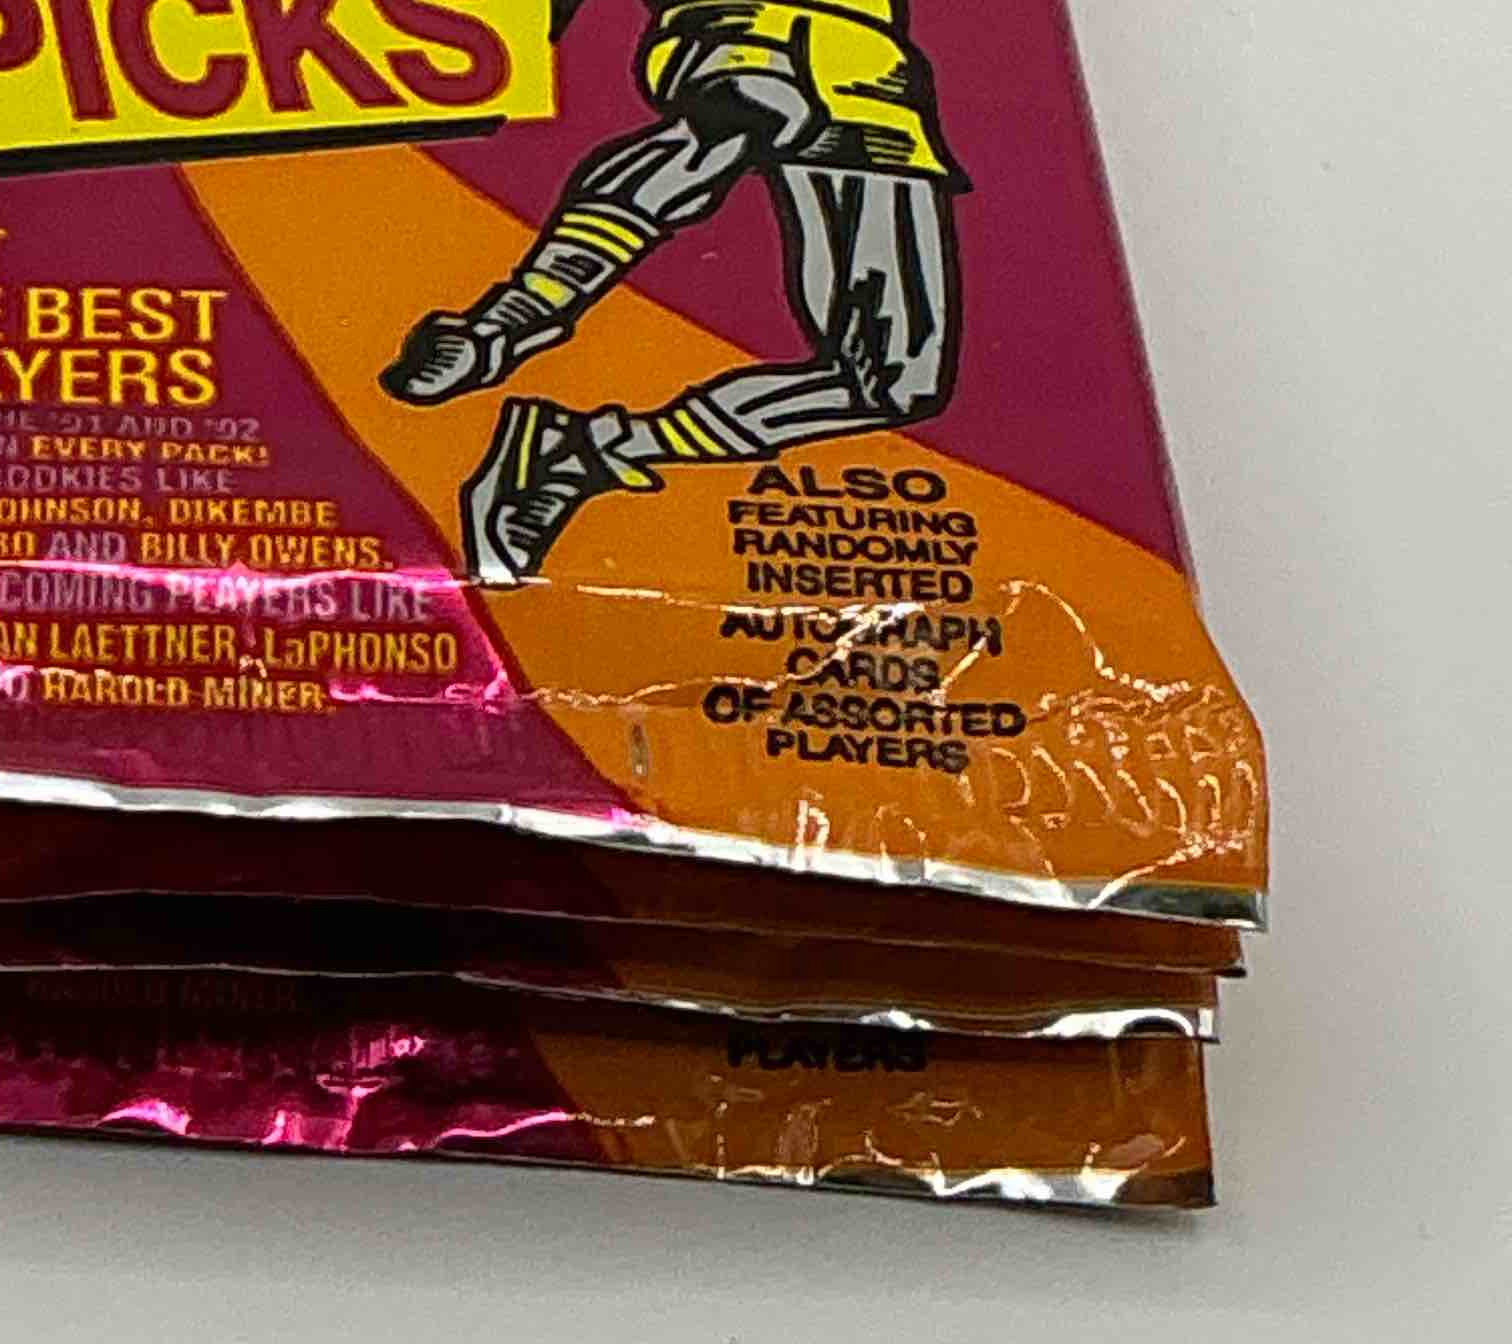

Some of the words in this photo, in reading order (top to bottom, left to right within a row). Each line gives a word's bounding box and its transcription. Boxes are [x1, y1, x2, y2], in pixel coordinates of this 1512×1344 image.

[26, 286, 227, 342] BEST
[115, 414, 192, 437] AND
[30, 435, 147, 460] EVERY
[159, 441, 269, 466] PACK!
[153, 468, 237, 494] LIKE
[747, 465, 947, 504] ALSO
[169, 498, 337, 529] DIKEMBE
[728, 499, 978, 538] FEATURING
[48, 531, 126, 561] AND
[140, 532, 236, 565] BILLY
[733, 527, 979, 566] RANDOMLY
[166, 574, 336, 616] PLAYERS
[351, 580, 433, 622] LIKE
[747, 561, 973, 603] INSERTED
[263, 626, 458, 673] LaPHONSO
[41, 668, 188, 705] HAROLD
[787, 646, 939, 693] CARDS
[703, 684, 774, 723] OF
[780, 691, 1027, 737] ASSORTED
[766, 727, 970, 774] PLAYERS
